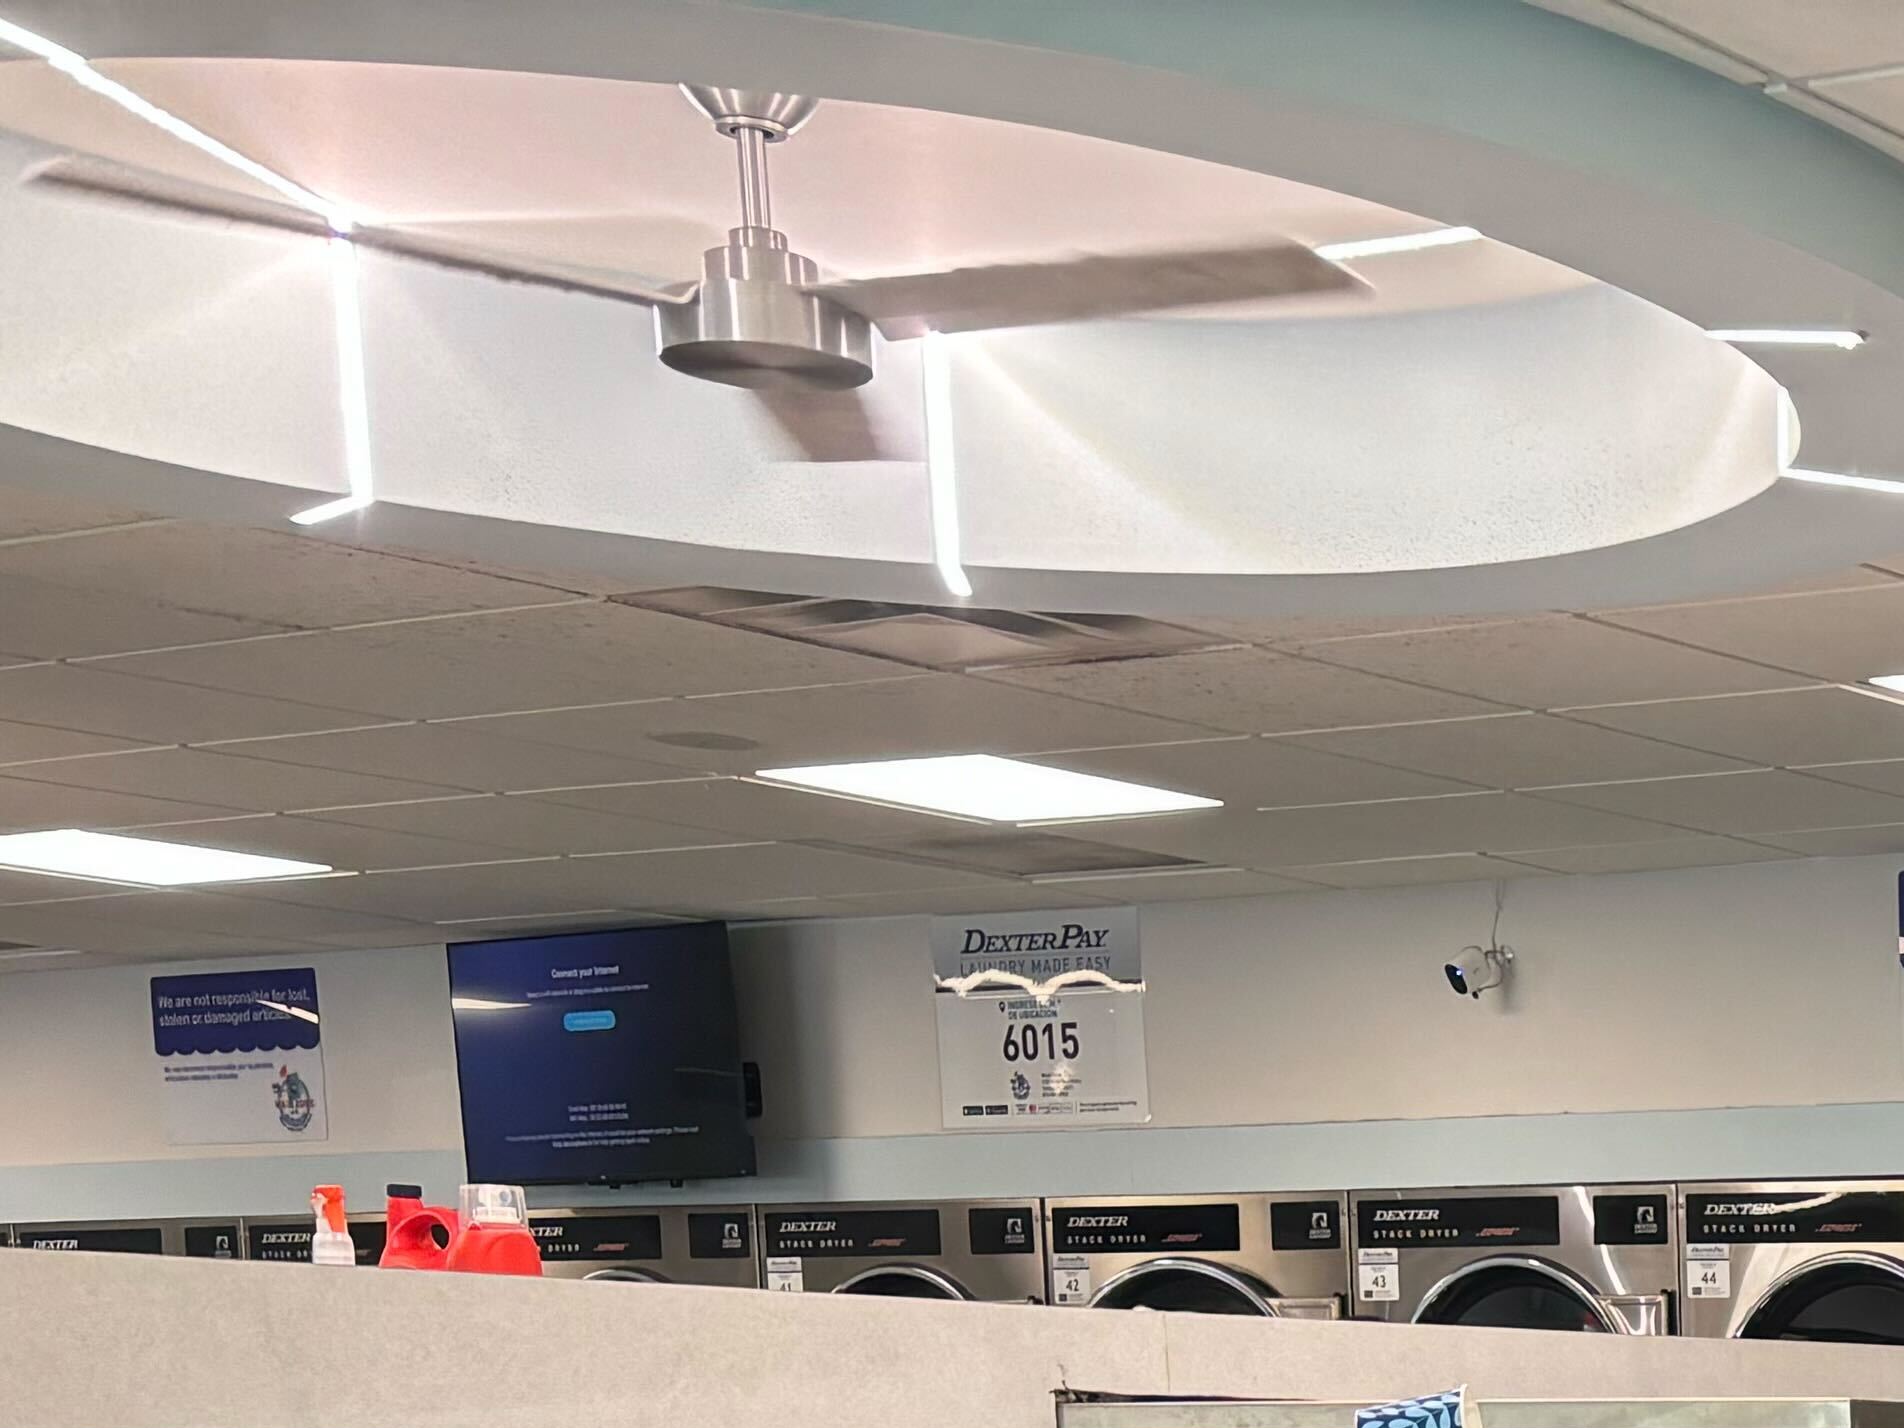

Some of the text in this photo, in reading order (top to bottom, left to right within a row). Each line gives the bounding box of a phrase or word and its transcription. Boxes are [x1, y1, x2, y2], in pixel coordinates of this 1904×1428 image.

[1031, 957, 1072, 973] MADE
[1076, 956, 1111, 971] EASY
[158, 996, 174, 1009] We
[175, 997, 192, 1007] are
[193, 994, 211, 1006] not
[212, 990, 270, 1006] responsible
[271, 988, 285, 1001] for
[159, 1010, 251, 1027] stolen or damaged
[1003, 1022, 1080, 1061] 6015
[1373, 1209, 1440, 1222] DEXTER
[1704, 1203, 1775, 1216] DEXTER
[779, 1221, 836, 1233] DEXTER
[1066, 1215, 1129, 1228] DEXTER
[531, 1226, 563, 1238] XTER
[1372, 1275, 1386, 1289] 43
[1701, 1272, 1717, 1285] 44
[1065, 1279, 1080, 1293] 42
